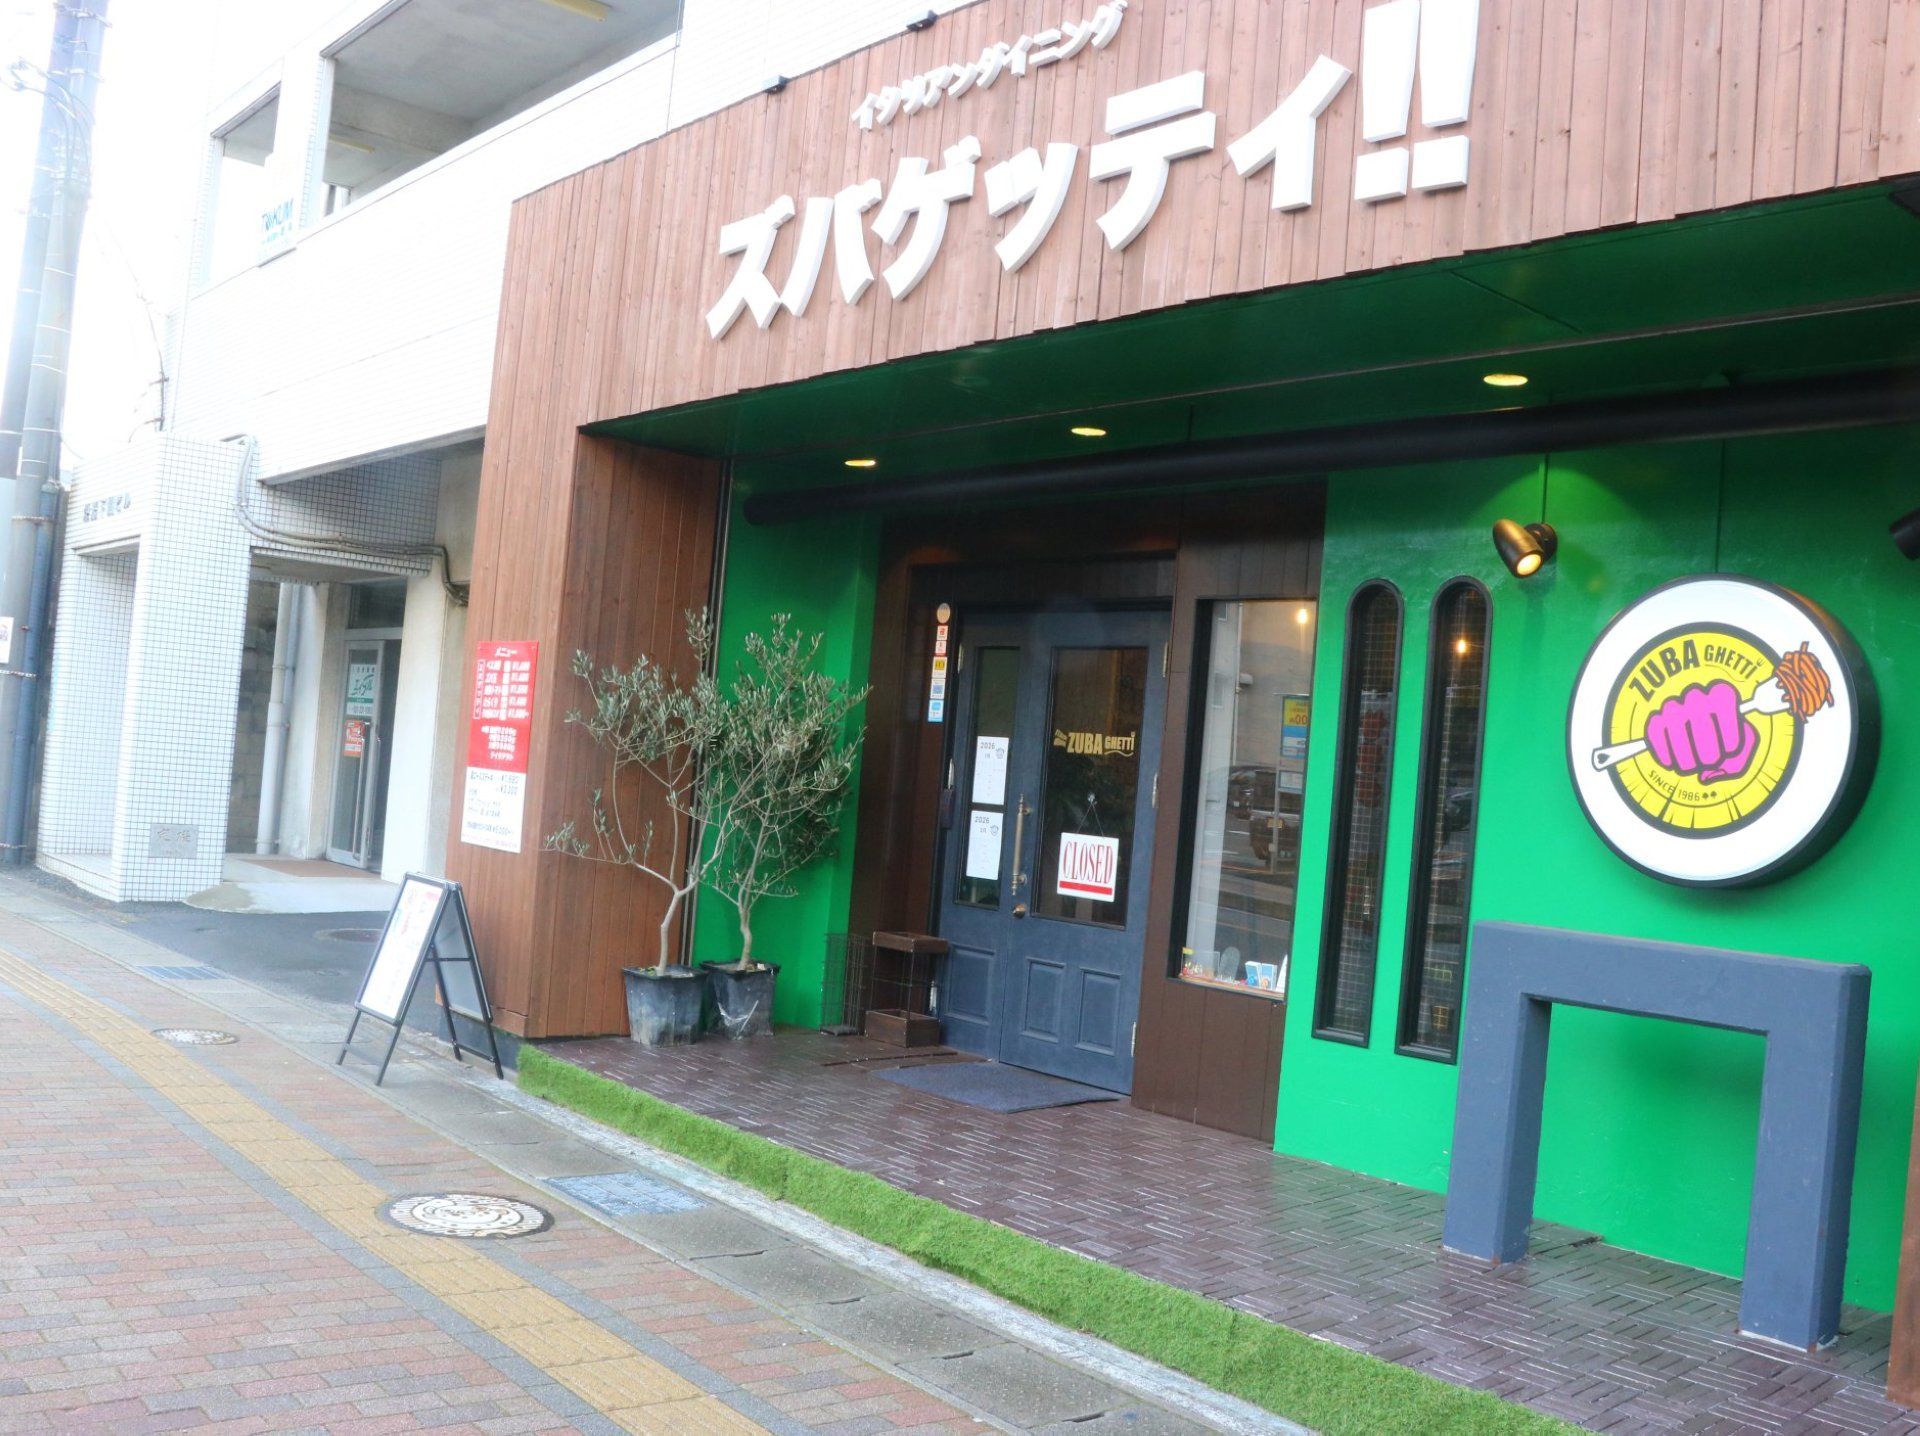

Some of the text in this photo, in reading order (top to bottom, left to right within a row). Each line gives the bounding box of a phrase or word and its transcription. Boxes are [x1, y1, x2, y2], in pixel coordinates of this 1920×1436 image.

[851, 1, 1128, 132] イタリアンダイニング
[1628, 639, 1763, 703] ZUBA GHETTI
[980, 742, 996, 750] 2026
[1067, 732, 1103, 755] ZUBA
[1104, 732, 1136, 751] GHETTI
[1648, 769, 1700, 802] SINCE 1986
[974, 816, 990, 824] 2026
[1063, 841, 1114, 884] CLOSED
